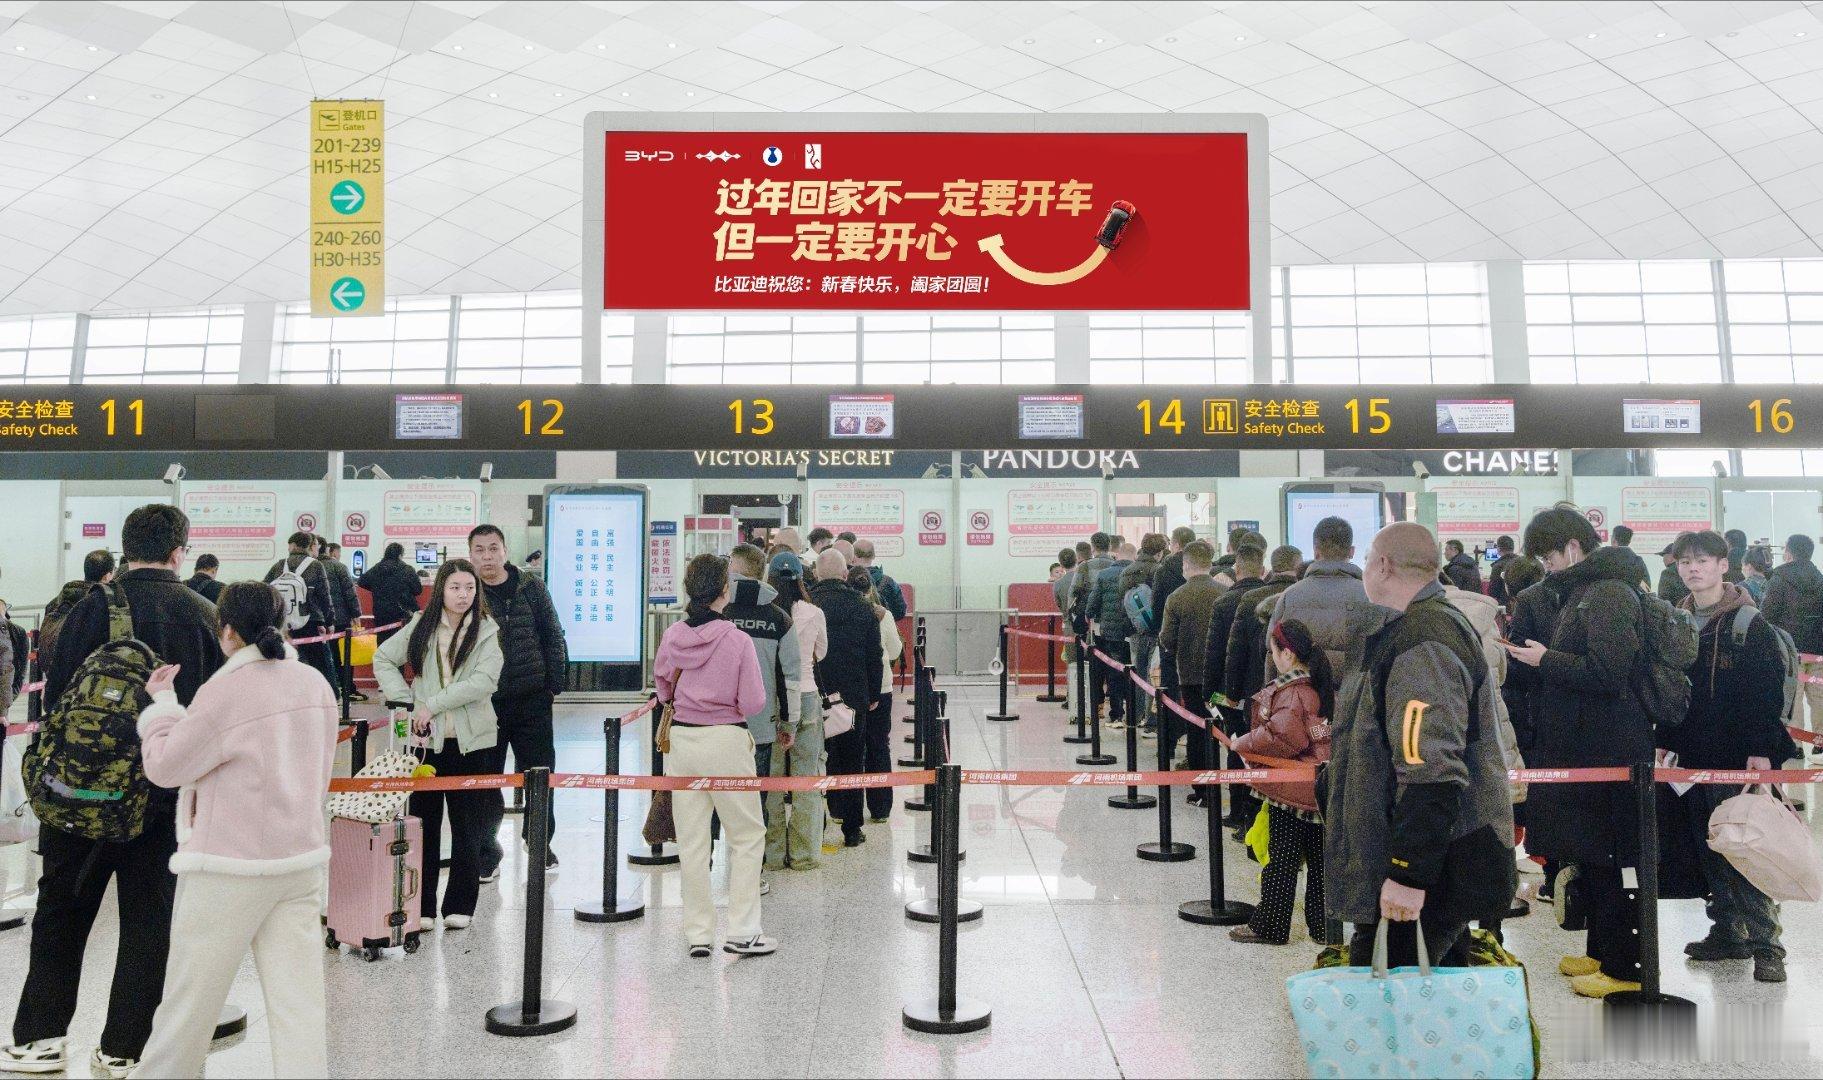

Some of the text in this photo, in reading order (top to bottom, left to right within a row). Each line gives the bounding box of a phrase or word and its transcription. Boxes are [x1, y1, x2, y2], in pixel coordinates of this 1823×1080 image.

[343, 109, 377, 121] 登机口
[343, 123, 365, 131] Gates
[314, 138, 381, 153] 201~239
[625, 150, 674, 162] BYD
[314, 159, 381, 174] H15~H25
[715, 178, 1094, 218] 过年回家不一定要开车
[314, 231, 382, 246] 240~260
[713, 221, 958, 262] 但一定要开心
[314, 252, 382, 267] H30~H35
[0, 399, 75, 419] 安全检查
[100, 399, 144, 435] 11
[516, 399, 564, 435] 12
[728, 399, 774, 435] 13
[1136, 399, 1186, 435] 14
[1244, 399, 1320, 418] 安全检查
[1344, 398, 1392, 434] 15
[1748, 398, 1795, 434] 16
[0, 423, 79, 438] afety Check
[1244, 422, 1325, 437] Safety Check
[694, 450, 895, 466] VICTORIA'S SECRET
[983, 449, 1140, 469] PANDORA
[606, 553, 614, 571] 民主
[590, 579, 598, 596] 公正
[606, 579, 614, 596] 文明
[731, 619, 776, 631] RORA
[1094, 773, 1142, 781] 河南机场集团
